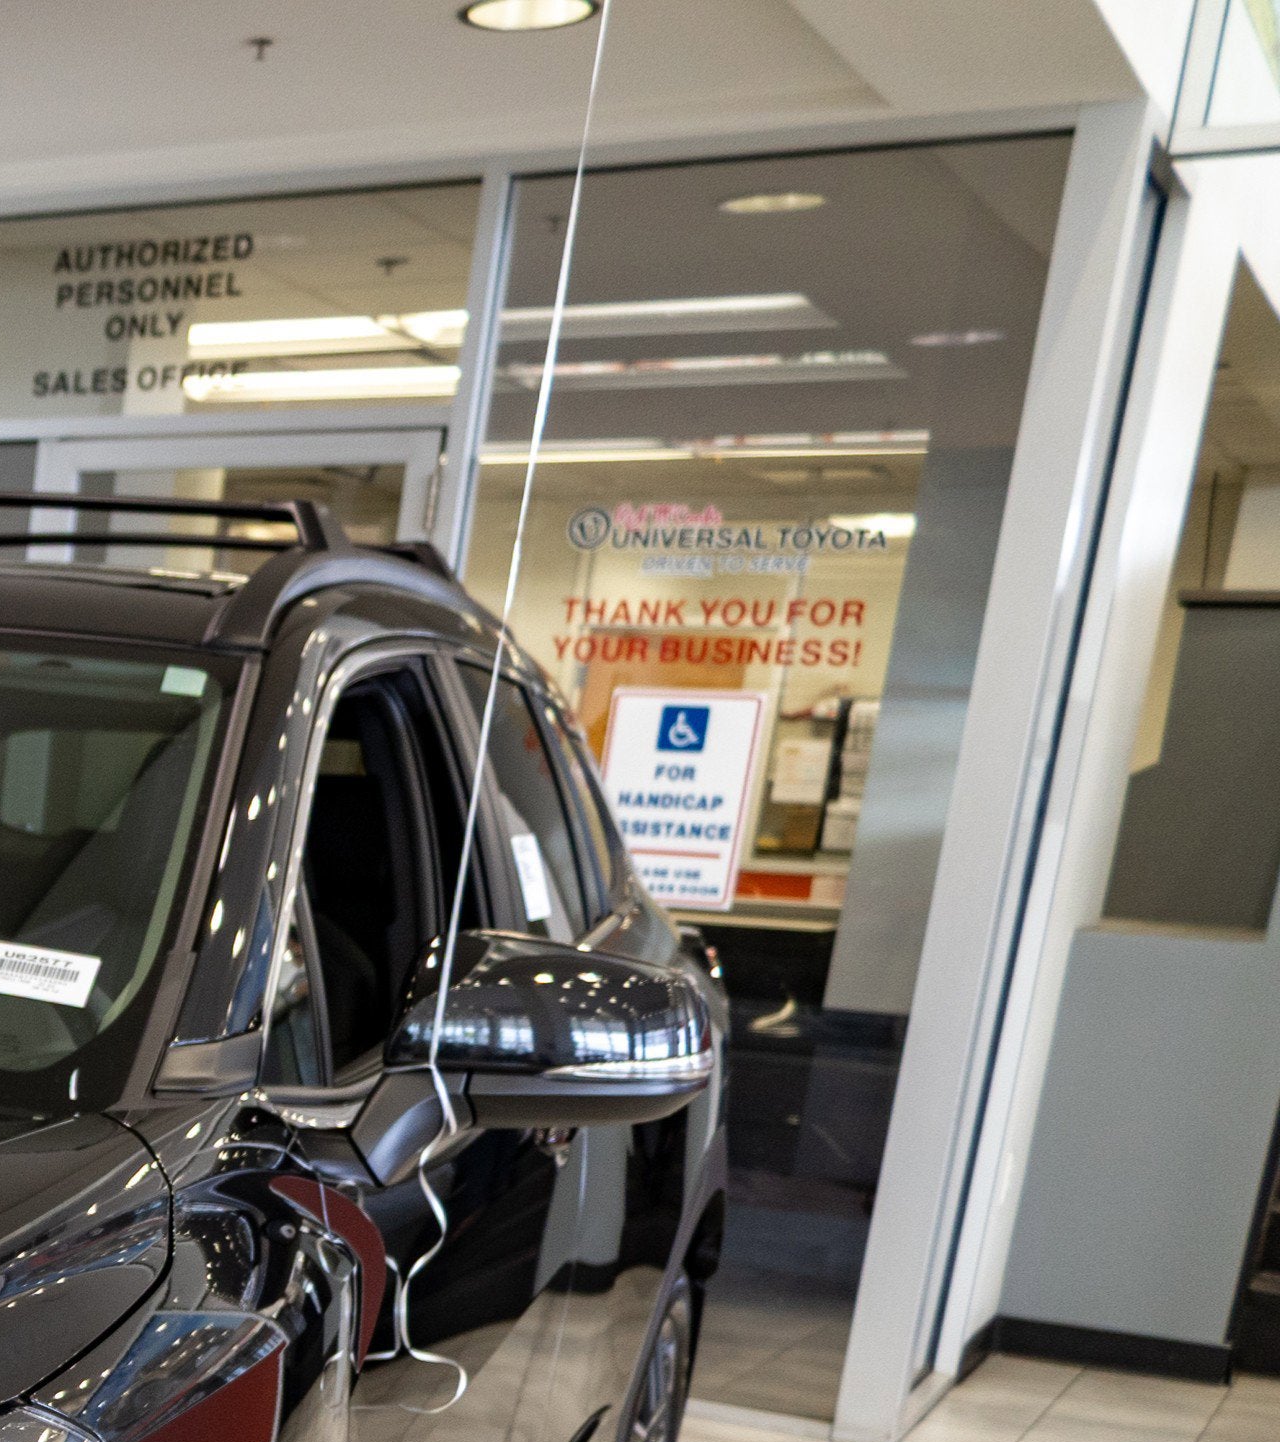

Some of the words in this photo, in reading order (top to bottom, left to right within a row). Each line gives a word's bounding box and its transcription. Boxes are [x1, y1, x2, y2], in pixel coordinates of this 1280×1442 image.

[54, 233, 252, 273] AUTHORIZED
[56, 272, 242, 309] PERSONNEL
[105, 311, 184, 342] ONLY
[32, 366, 128, 397] SALES
[612, 527, 768, 550] UNIVERSAL
[777, 527, 887, 550] TOYOTA
[562, 599, 687, 626] THANK
[700, 599, 776, 627] YOU
[786, 599, 865, 627] FOR
[552, 636, 649, 664] YOUR
[658, 637, 863, 668] BUSINESS!
[654, 763, 697, 781] FOR
[617, 790, 724, 811] HANDICAP
